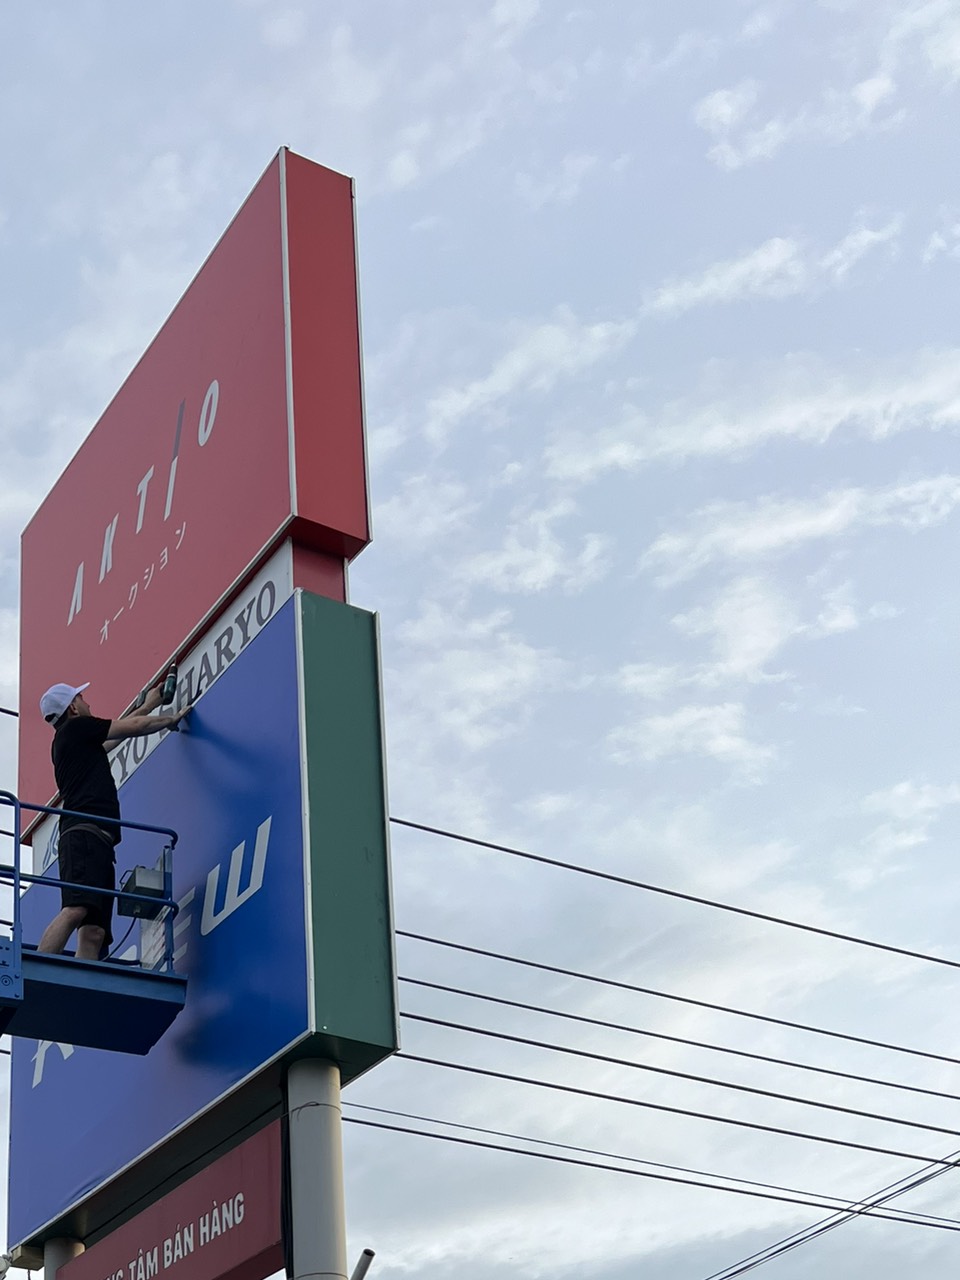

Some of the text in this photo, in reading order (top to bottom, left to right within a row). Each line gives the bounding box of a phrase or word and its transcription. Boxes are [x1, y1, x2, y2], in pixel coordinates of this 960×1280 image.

[67, 379, 219, 626] AKTIO
[163, 1223, 194, 1269] BÁN
[199, 1192, 245, 1247] HÀNG
